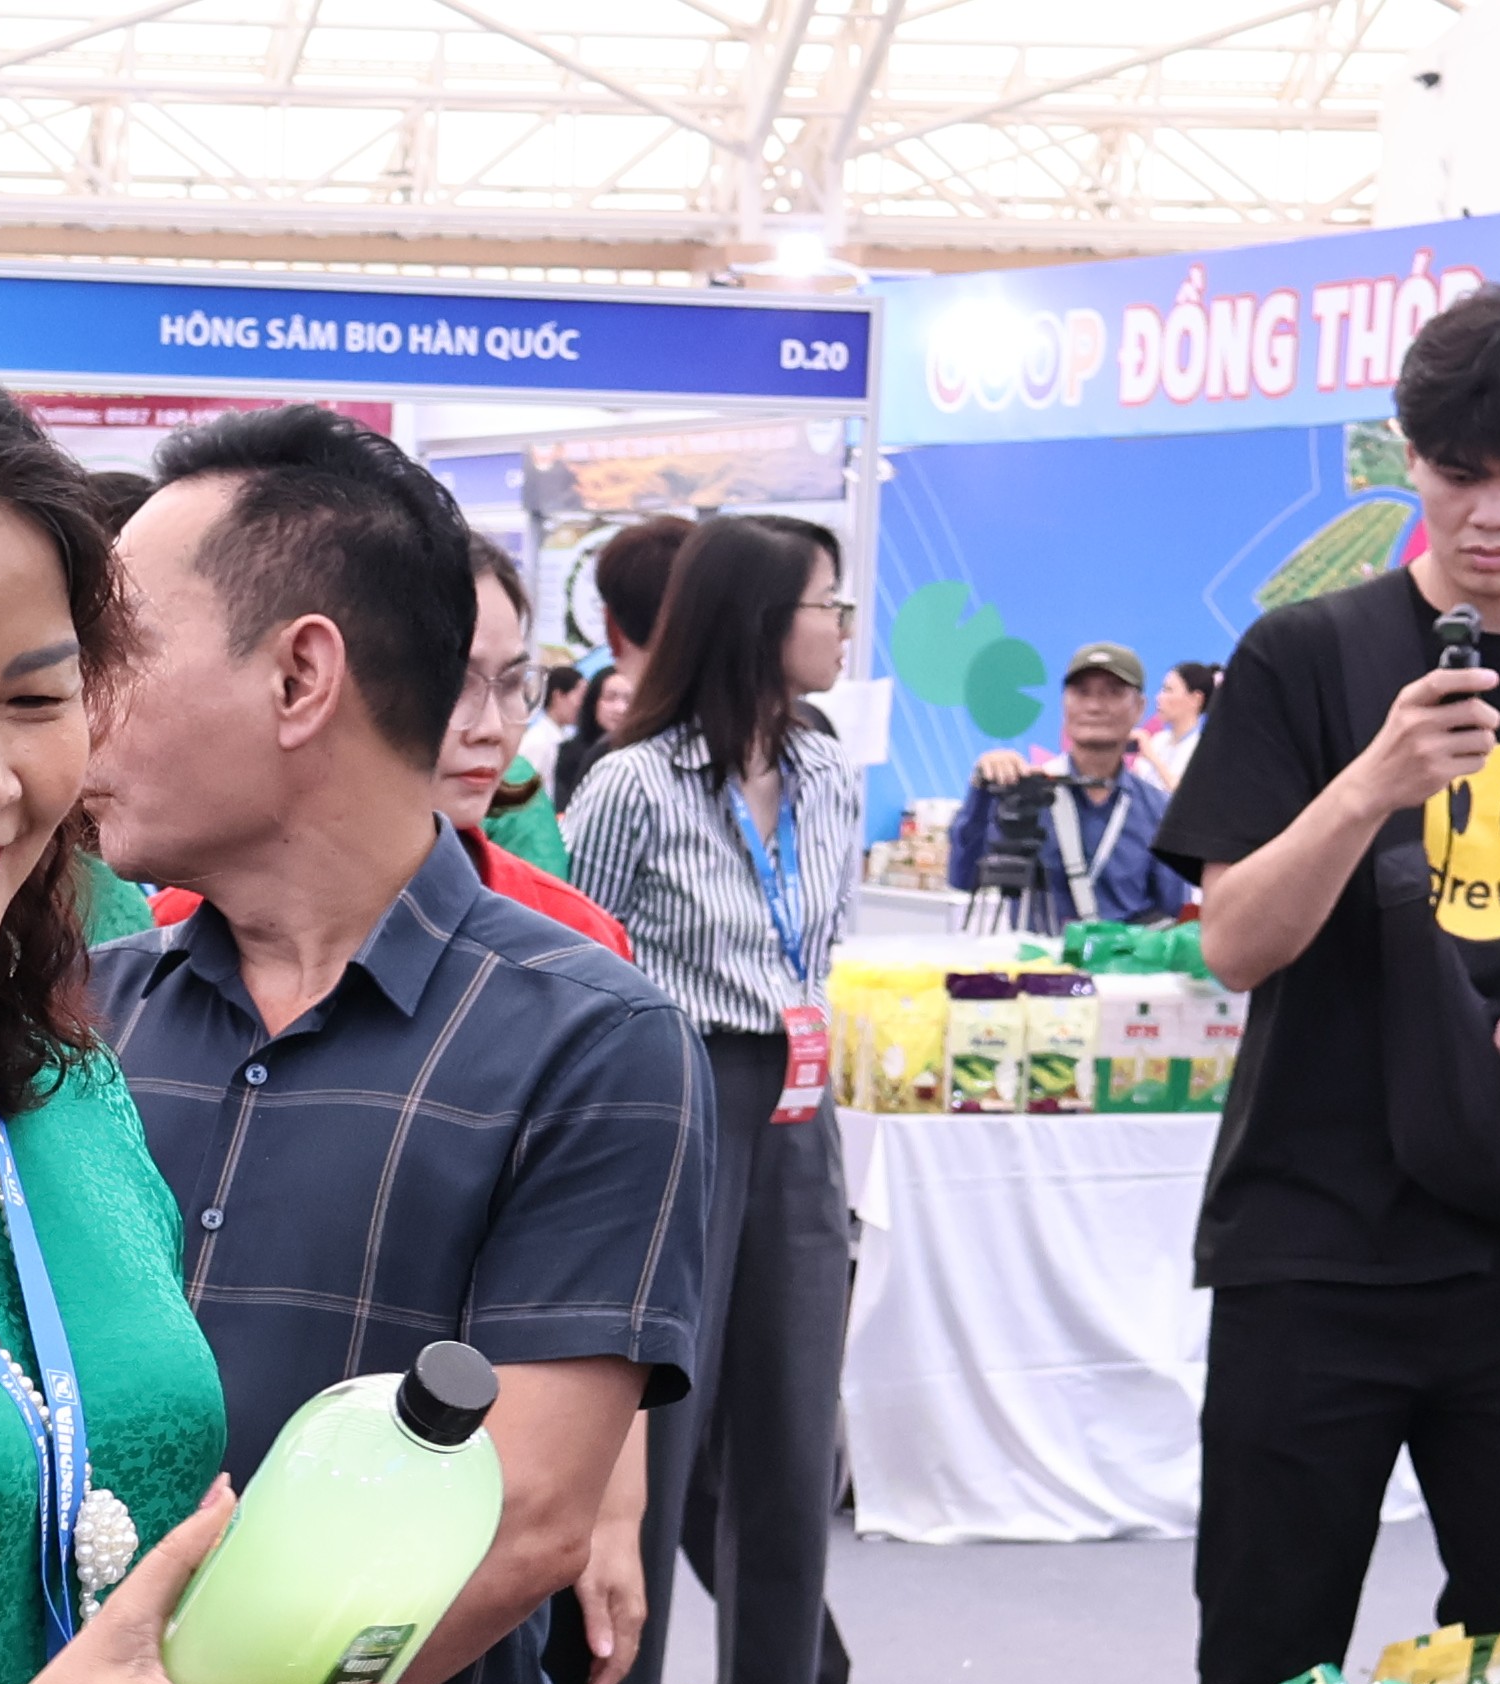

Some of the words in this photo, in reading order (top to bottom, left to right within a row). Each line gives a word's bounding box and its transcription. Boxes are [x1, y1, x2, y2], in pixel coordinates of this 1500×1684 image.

[266, 312, 339, 352] SÂM
[345, 321, 401, 355] BIO
[408, 315, 479, 357] HÀN
[486, 321, 581, 362] QUỐC
[779, 339, 849, 373] D.20
